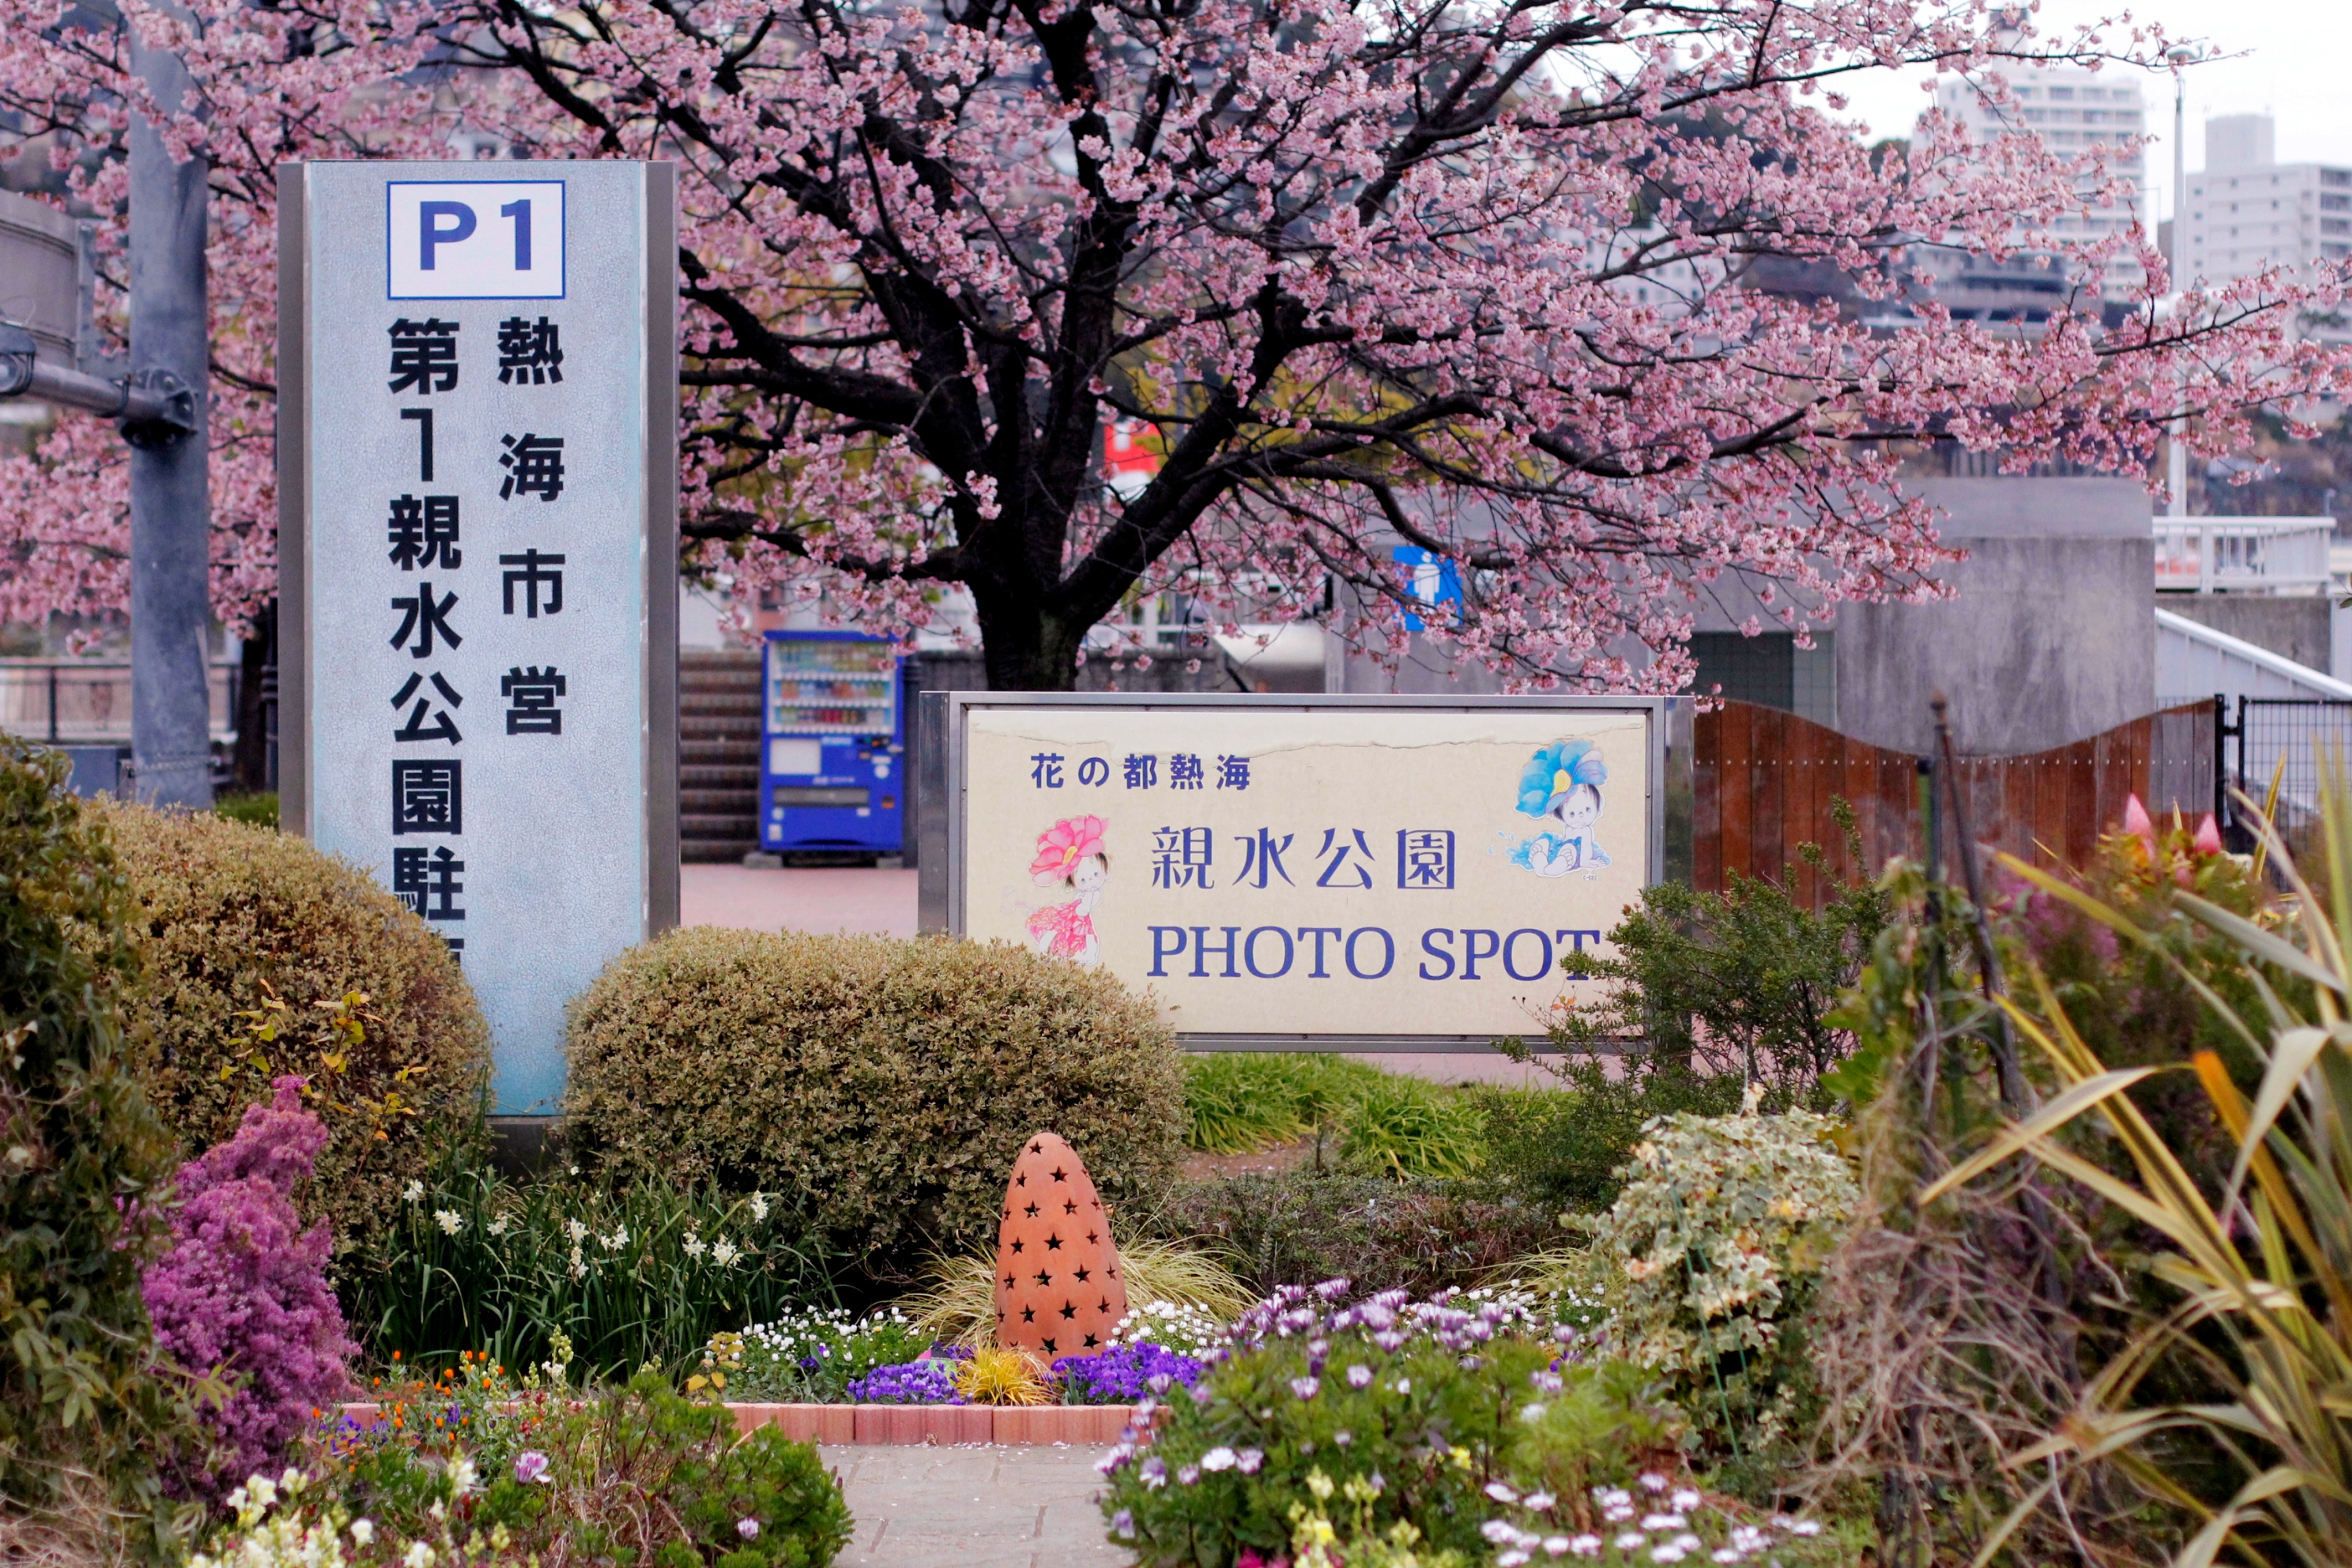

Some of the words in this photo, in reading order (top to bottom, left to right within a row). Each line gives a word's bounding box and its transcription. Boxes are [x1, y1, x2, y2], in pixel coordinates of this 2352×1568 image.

[419, 199, 532, 271] P1
[497, 317, 565, 735] 熱海市営
[387, 318, 466, 967] 第1親水公園駐
[1030, 753, 1251, 790] 花の都熱海
[1151, 826, 1456, 890] 親水公園
[1146, 925, 1396, 980] PHOTO
[1419, 927, 1600, 981] SPOT
